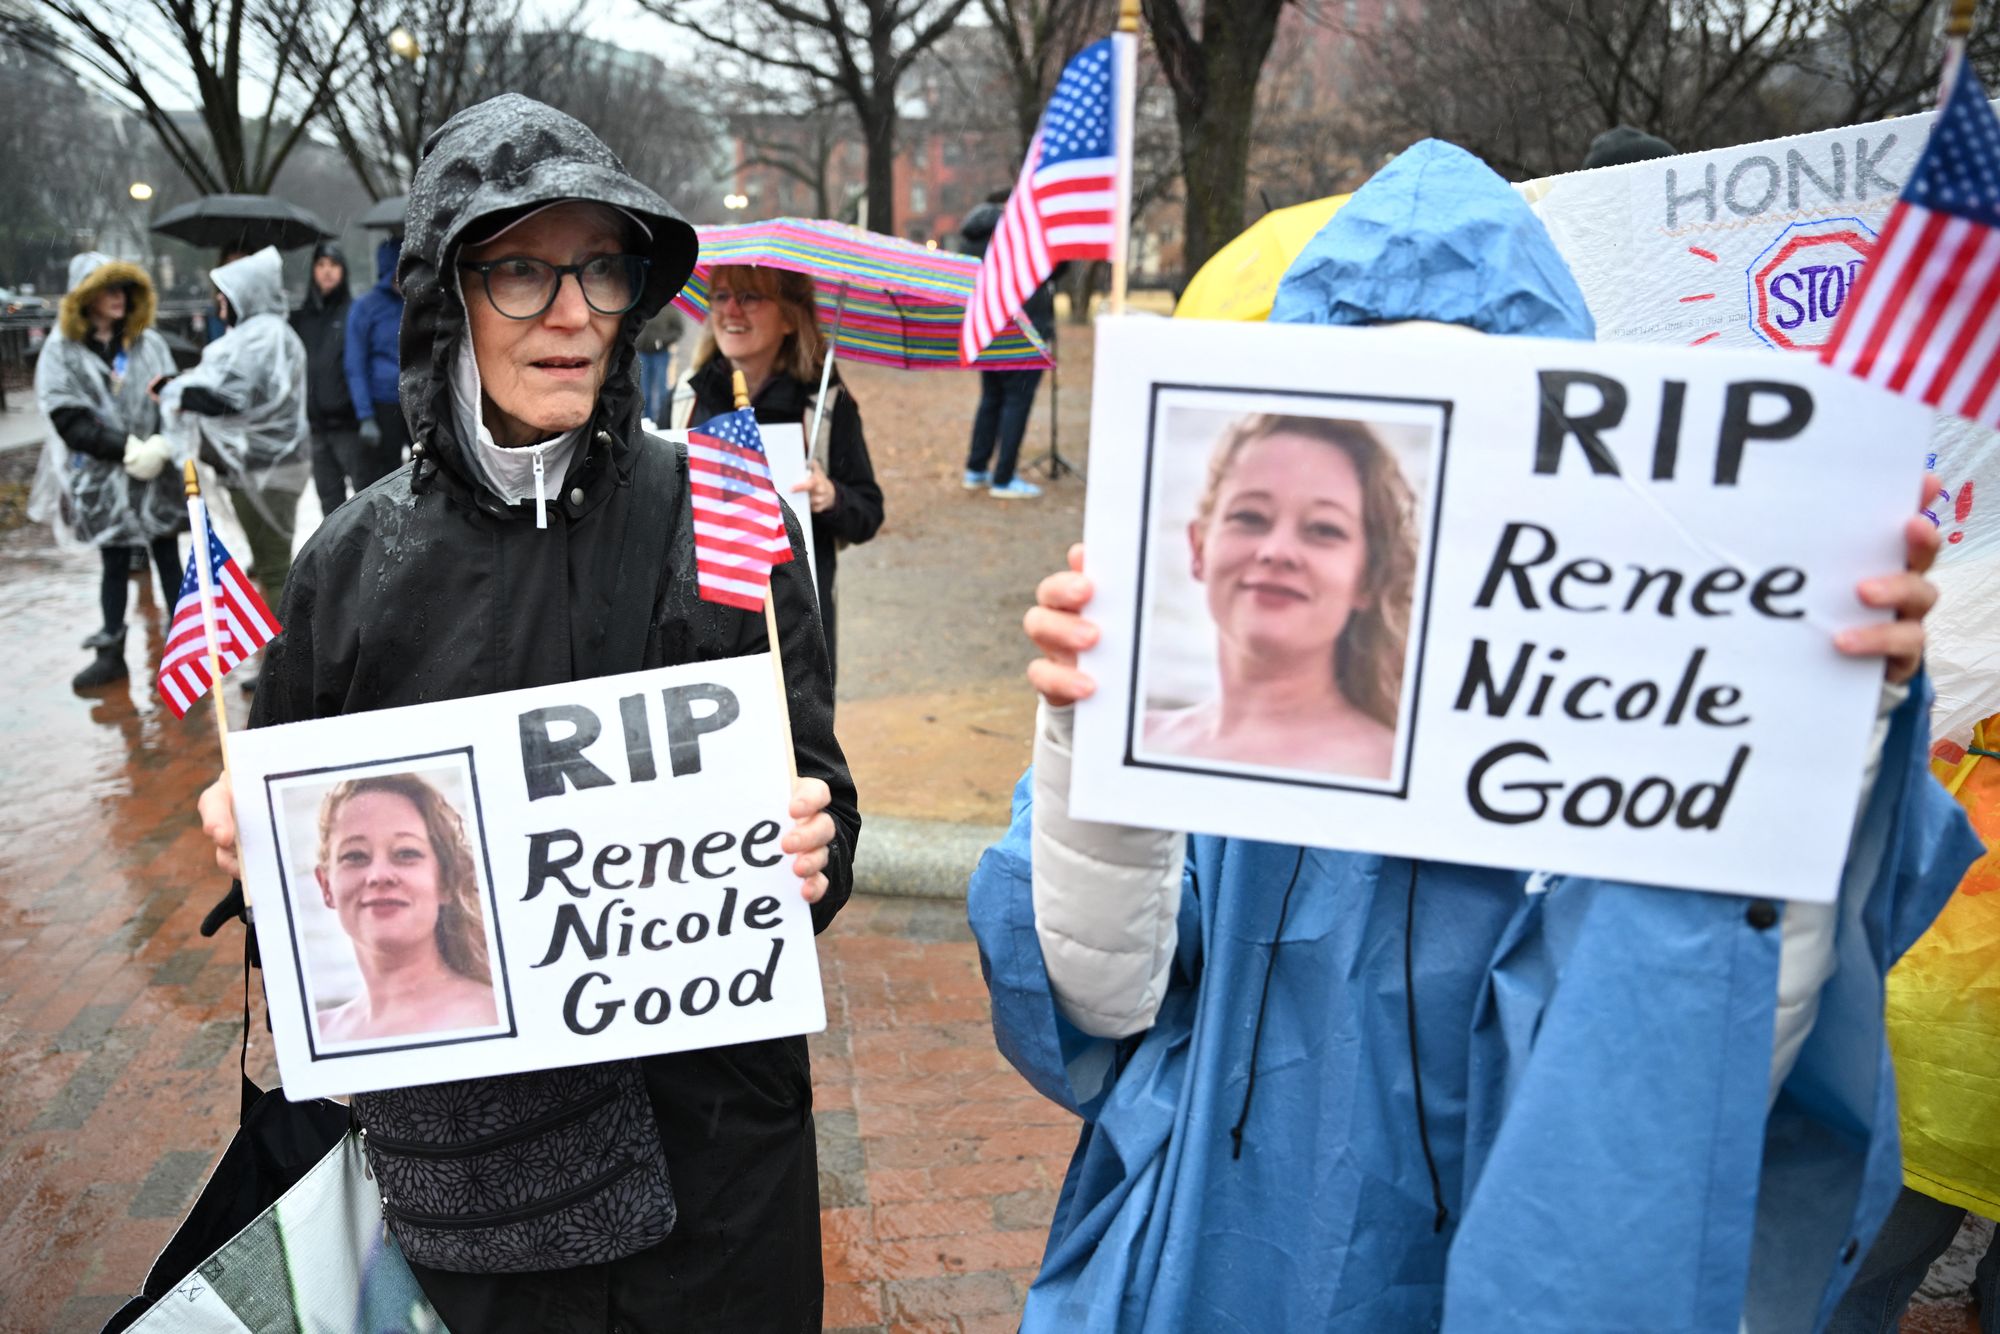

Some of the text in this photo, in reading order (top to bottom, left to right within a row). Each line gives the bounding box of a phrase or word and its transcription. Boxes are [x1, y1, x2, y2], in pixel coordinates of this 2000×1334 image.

[1666, 132, 1899, 229] HONK
[1533, 368, 1815, 487] RIP
[1473, 521, 1807, 620] Renee
[1453, 637, 1752, 727] Nicole
[518, 682, 740, 802] RIP
[1466, 740, 1752, 831] Good
[519, 820, 784, 902] Renee
[529, 887, 785, 969] Nicole
[562, 938, 785, 1036] Good
